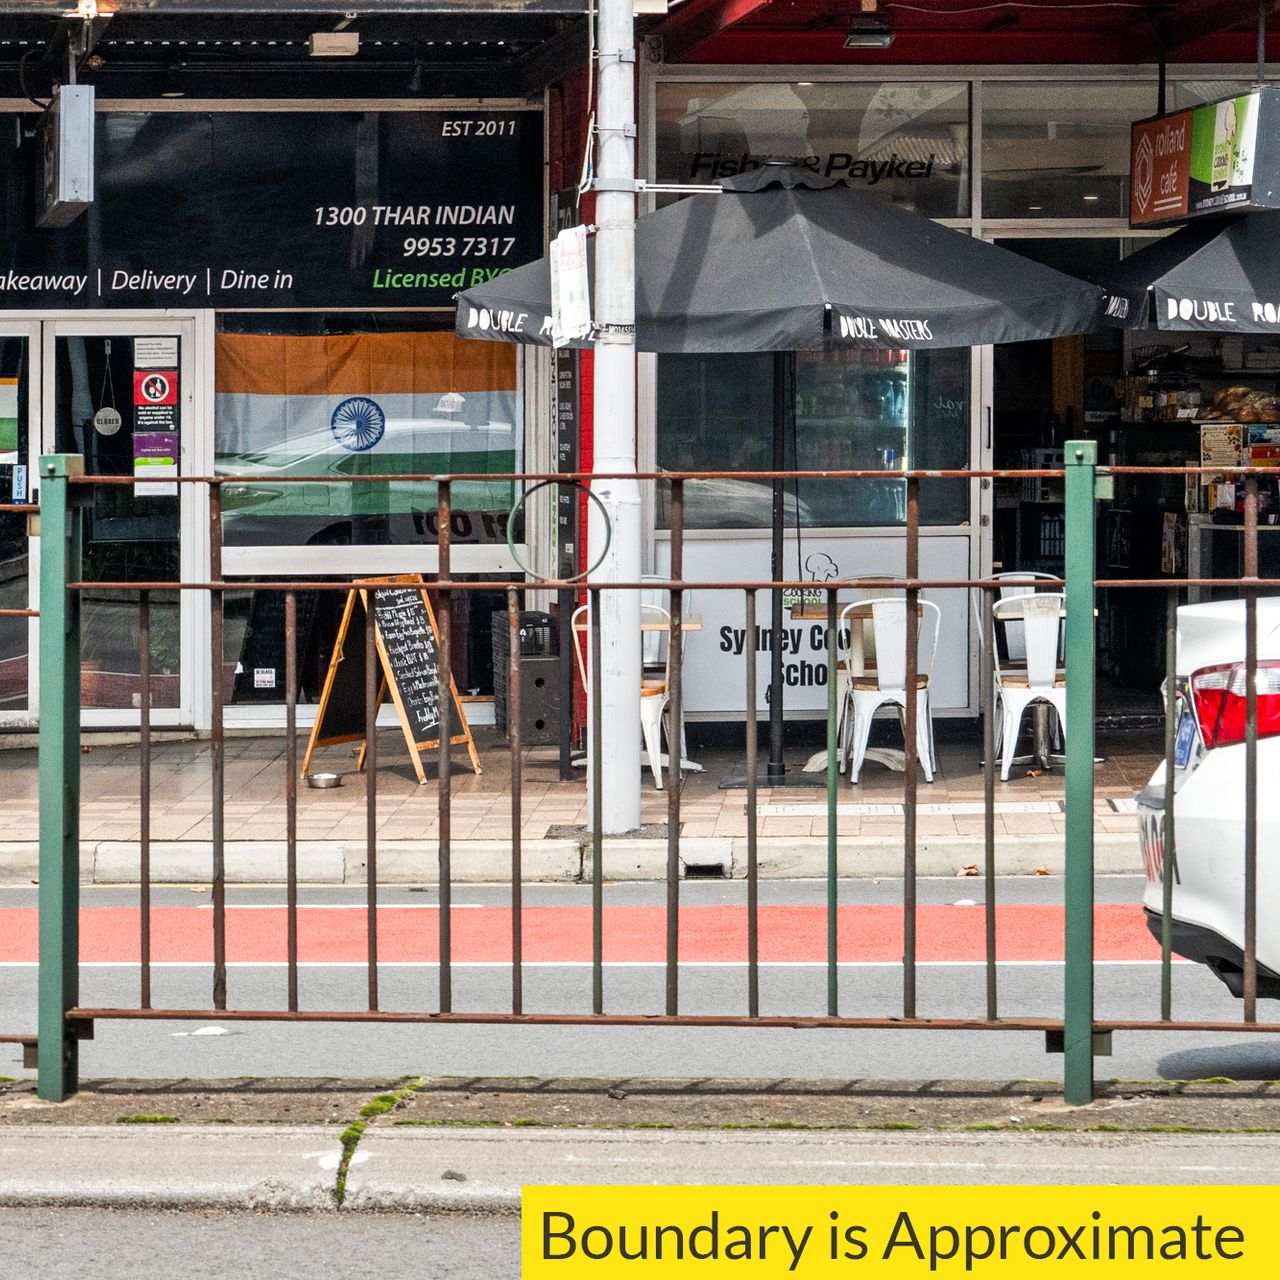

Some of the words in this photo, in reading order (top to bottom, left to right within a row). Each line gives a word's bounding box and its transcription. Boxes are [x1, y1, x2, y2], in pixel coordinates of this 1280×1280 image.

[442, 119, 472, 137] EST
[475, 119, 516, 136] 2011
[1155, 120, 1186, 158] rolland
[691, 152, 762, 179] Fish
[825, 152, 934, 186] Paykel
[314, 206, 366, 226] 1300
[371, 206, 431, 226] THAR
[434, 205, 515, 225] INDIAN
[403, 237, 456, 257] 9953
[461, 237, 516, 257] 7317
[111, 269, 197, 296] Delivery
[220, 269, 269, 290] Dine
[274, 271, 293, 289] in
[373, 266, 466, 290] Licensed
[467, 307, 529, 333] DOUBLE
[1167, 298, 1237, 323] DOUBLE
[1251, 302, 1280, 324] RO
